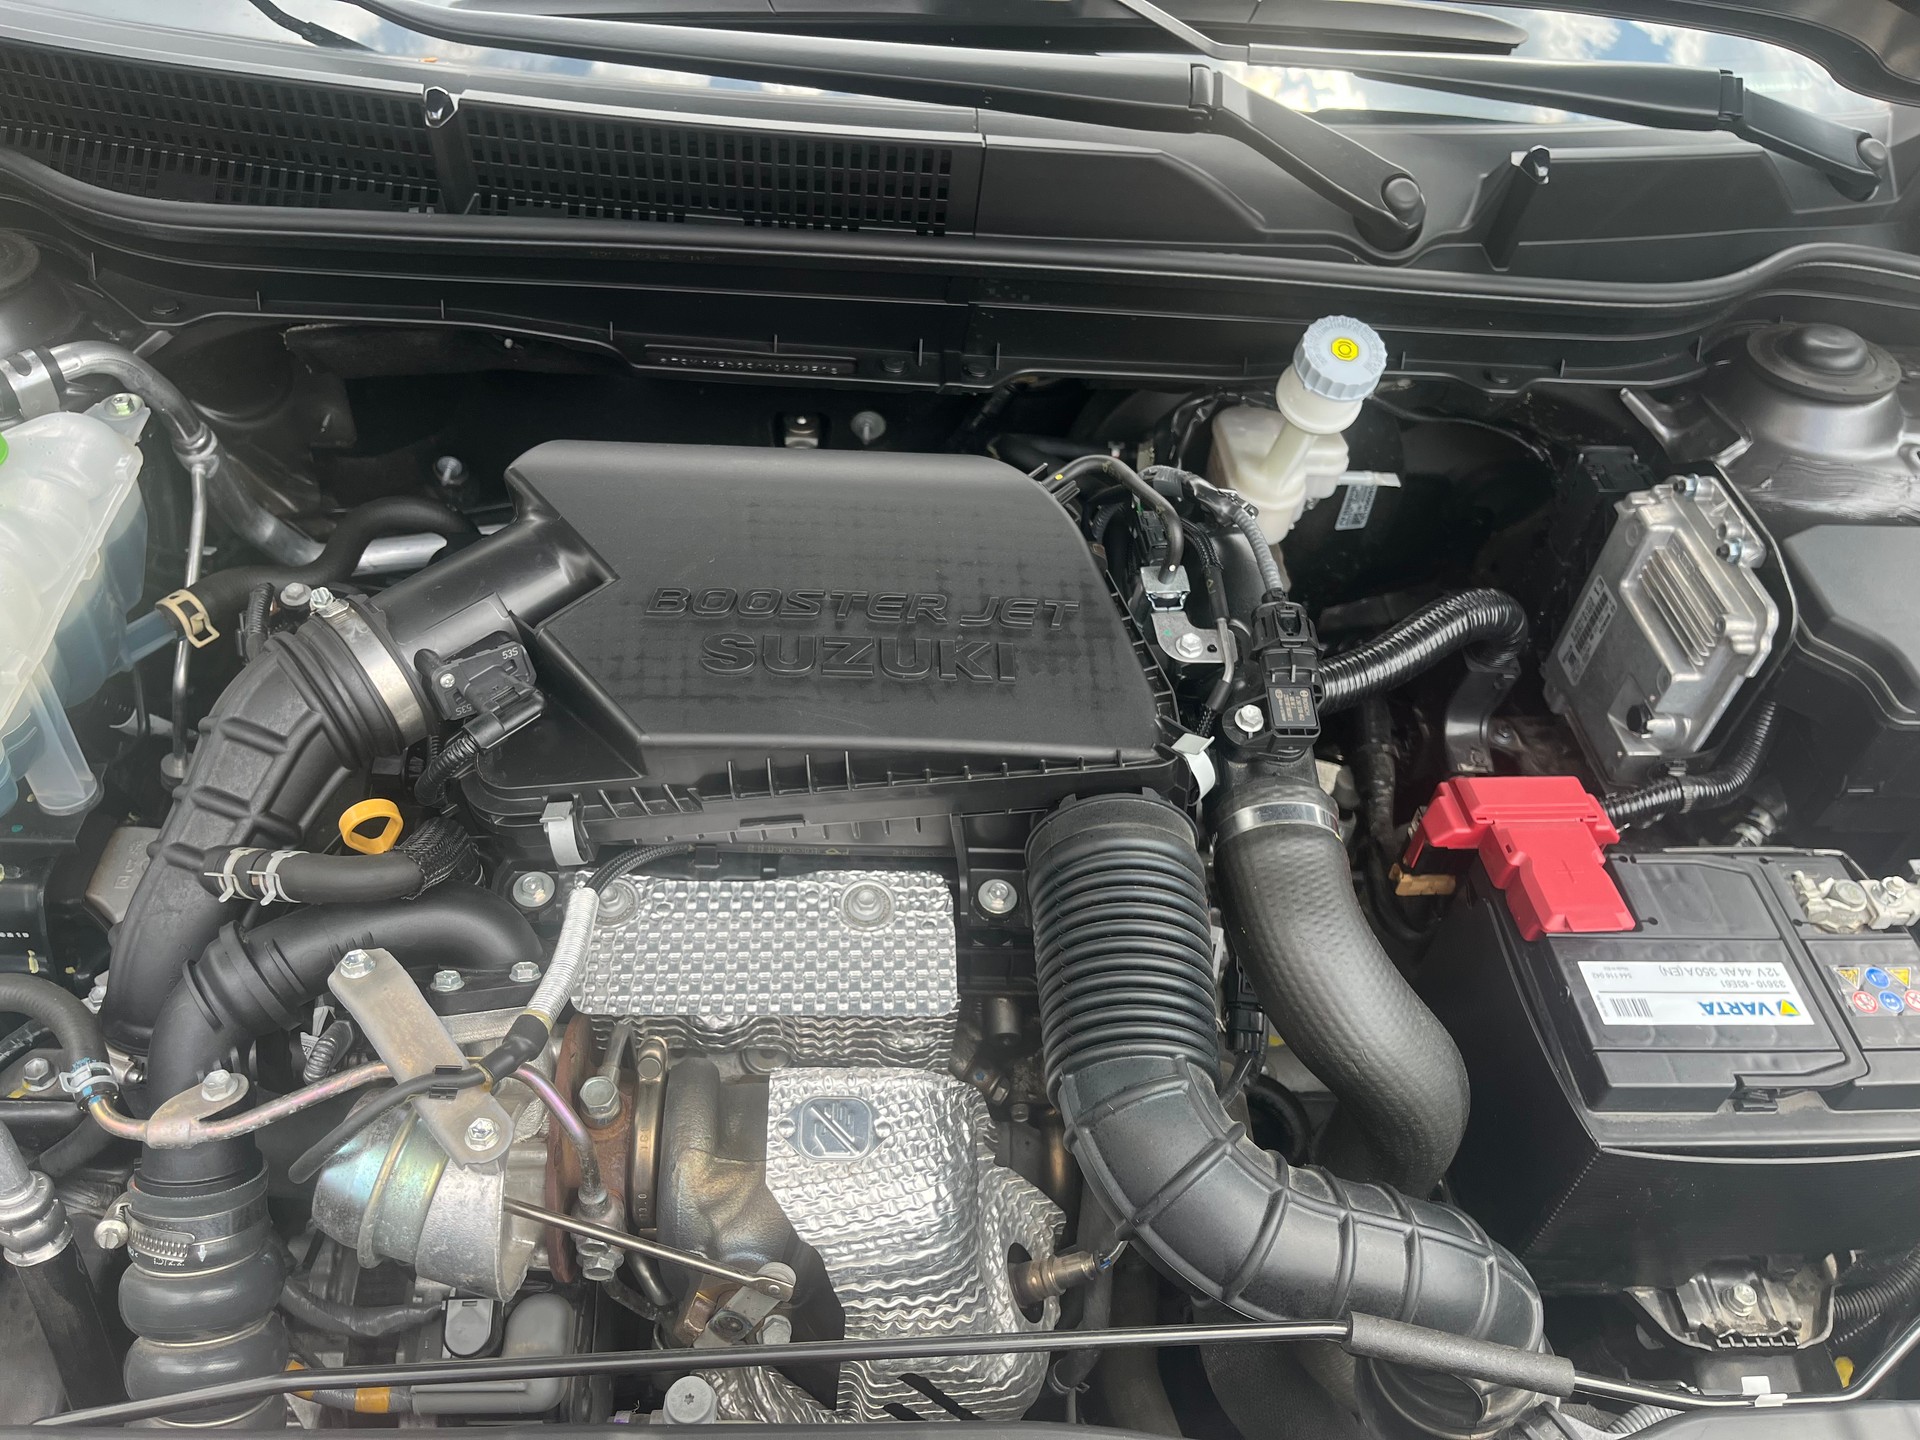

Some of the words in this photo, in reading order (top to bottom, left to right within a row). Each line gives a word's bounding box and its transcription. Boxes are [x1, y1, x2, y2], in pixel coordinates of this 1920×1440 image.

[644, 586, 949, 625] BOOSTER
[959, 595, 1081, 629] JET
[699, 631, 1018, 682] SUZUKI
[1697, 1001, 1776, 1017] VARTA
